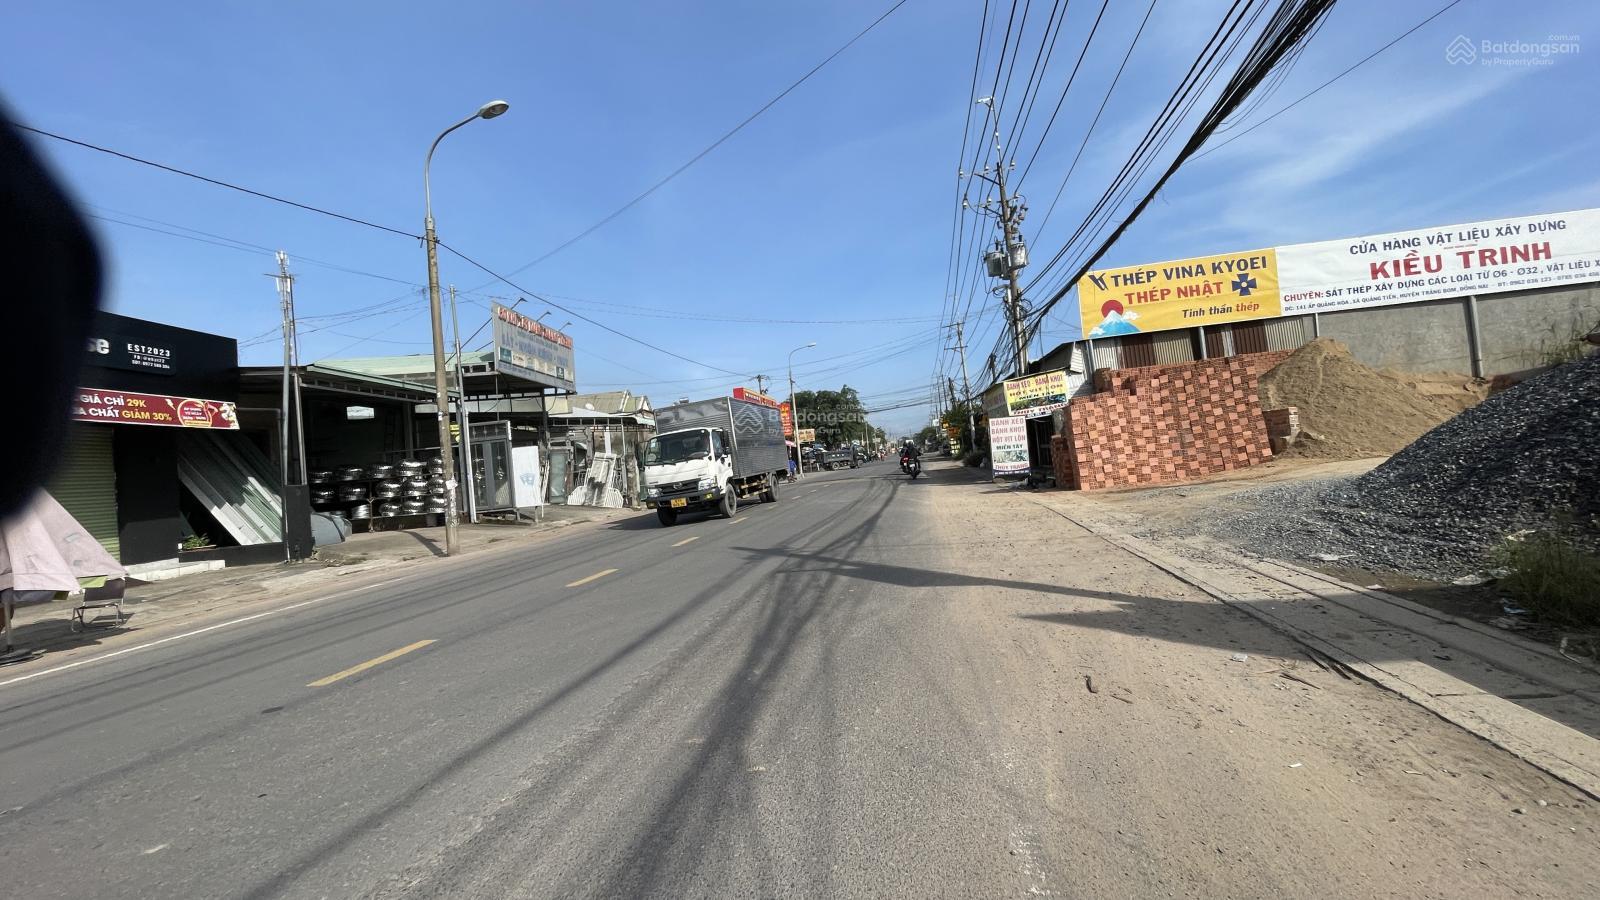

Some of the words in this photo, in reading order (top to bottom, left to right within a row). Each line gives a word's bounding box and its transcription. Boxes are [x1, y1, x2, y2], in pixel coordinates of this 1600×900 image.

[1349, 241, 1377, 255] CỬA
[1382, 235, 1421, 251] HÀNG
[1426, 230, 1453, 247] VẬT
[1458, 226, 1490, 243] LIỆU
[1495, 222, 1521, 237] XÂY
[1528, 219, 1567, 236] DỰNG
[1369, 249, 1443, 280] KIỀU
[1456, 241, 1552, 270] TRINH
[1111, 268, 1158, 288] THÉP
[1162, 264, 1206, 281] VINA
[1211, 255, 1267, 275] KYOEI
[1124, 286, 1172, 305] THÉP
[1176, 279, 1224, 299] NHẬT
[1181, 308, 1205, 319] Tinh
[127, 343, 170, 357] EST2023
[80, 394, 103, 404] GIÁ
[103, 395, 125, 406] CHỈ
[126, 398, 147, 408] 29K
[88, 406, 120, 418] CHẤT
[121, 408, 151, 420] GIẢM
[152, 412, 173, 421] 30%
